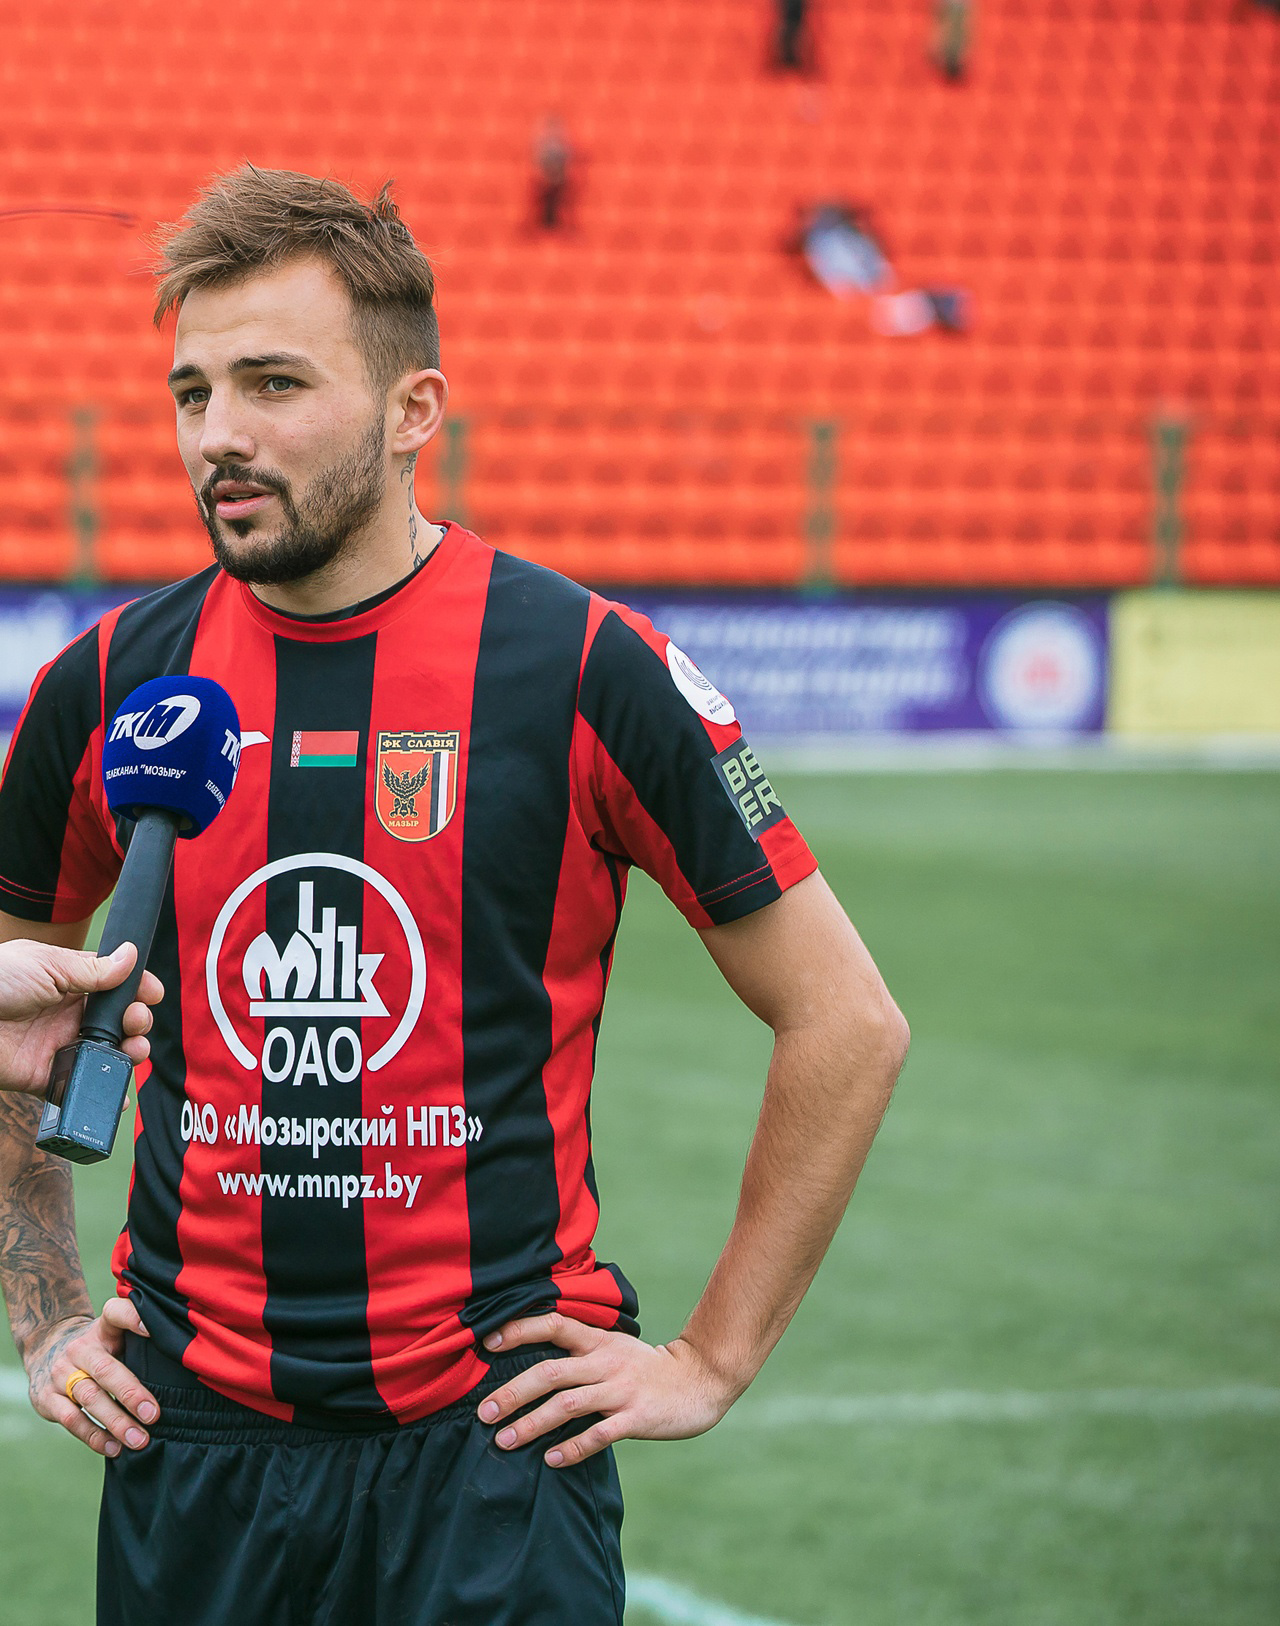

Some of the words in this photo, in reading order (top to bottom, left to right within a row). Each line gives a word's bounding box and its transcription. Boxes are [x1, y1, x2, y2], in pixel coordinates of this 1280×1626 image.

[382, 739, 402, 748] ФК
[407, 739, 454, 748] СЛАВІЯ
[106, 765, 138, 780] ТЕЛЕКАНАЛ
[388, 820, 420, 828] МАЗЫР
[261, 1026, 363, 1086] ОАО
[72, 1129, 105, 1147] SENNHEISER
[180, 1099, 219, 1145] ОАО
[223, 1103, 397, 1159] «Мозырский
[406, 1104, 484, 1147] НПЗ»
[216, 1161, 423, 1209] www.mnpz.by
